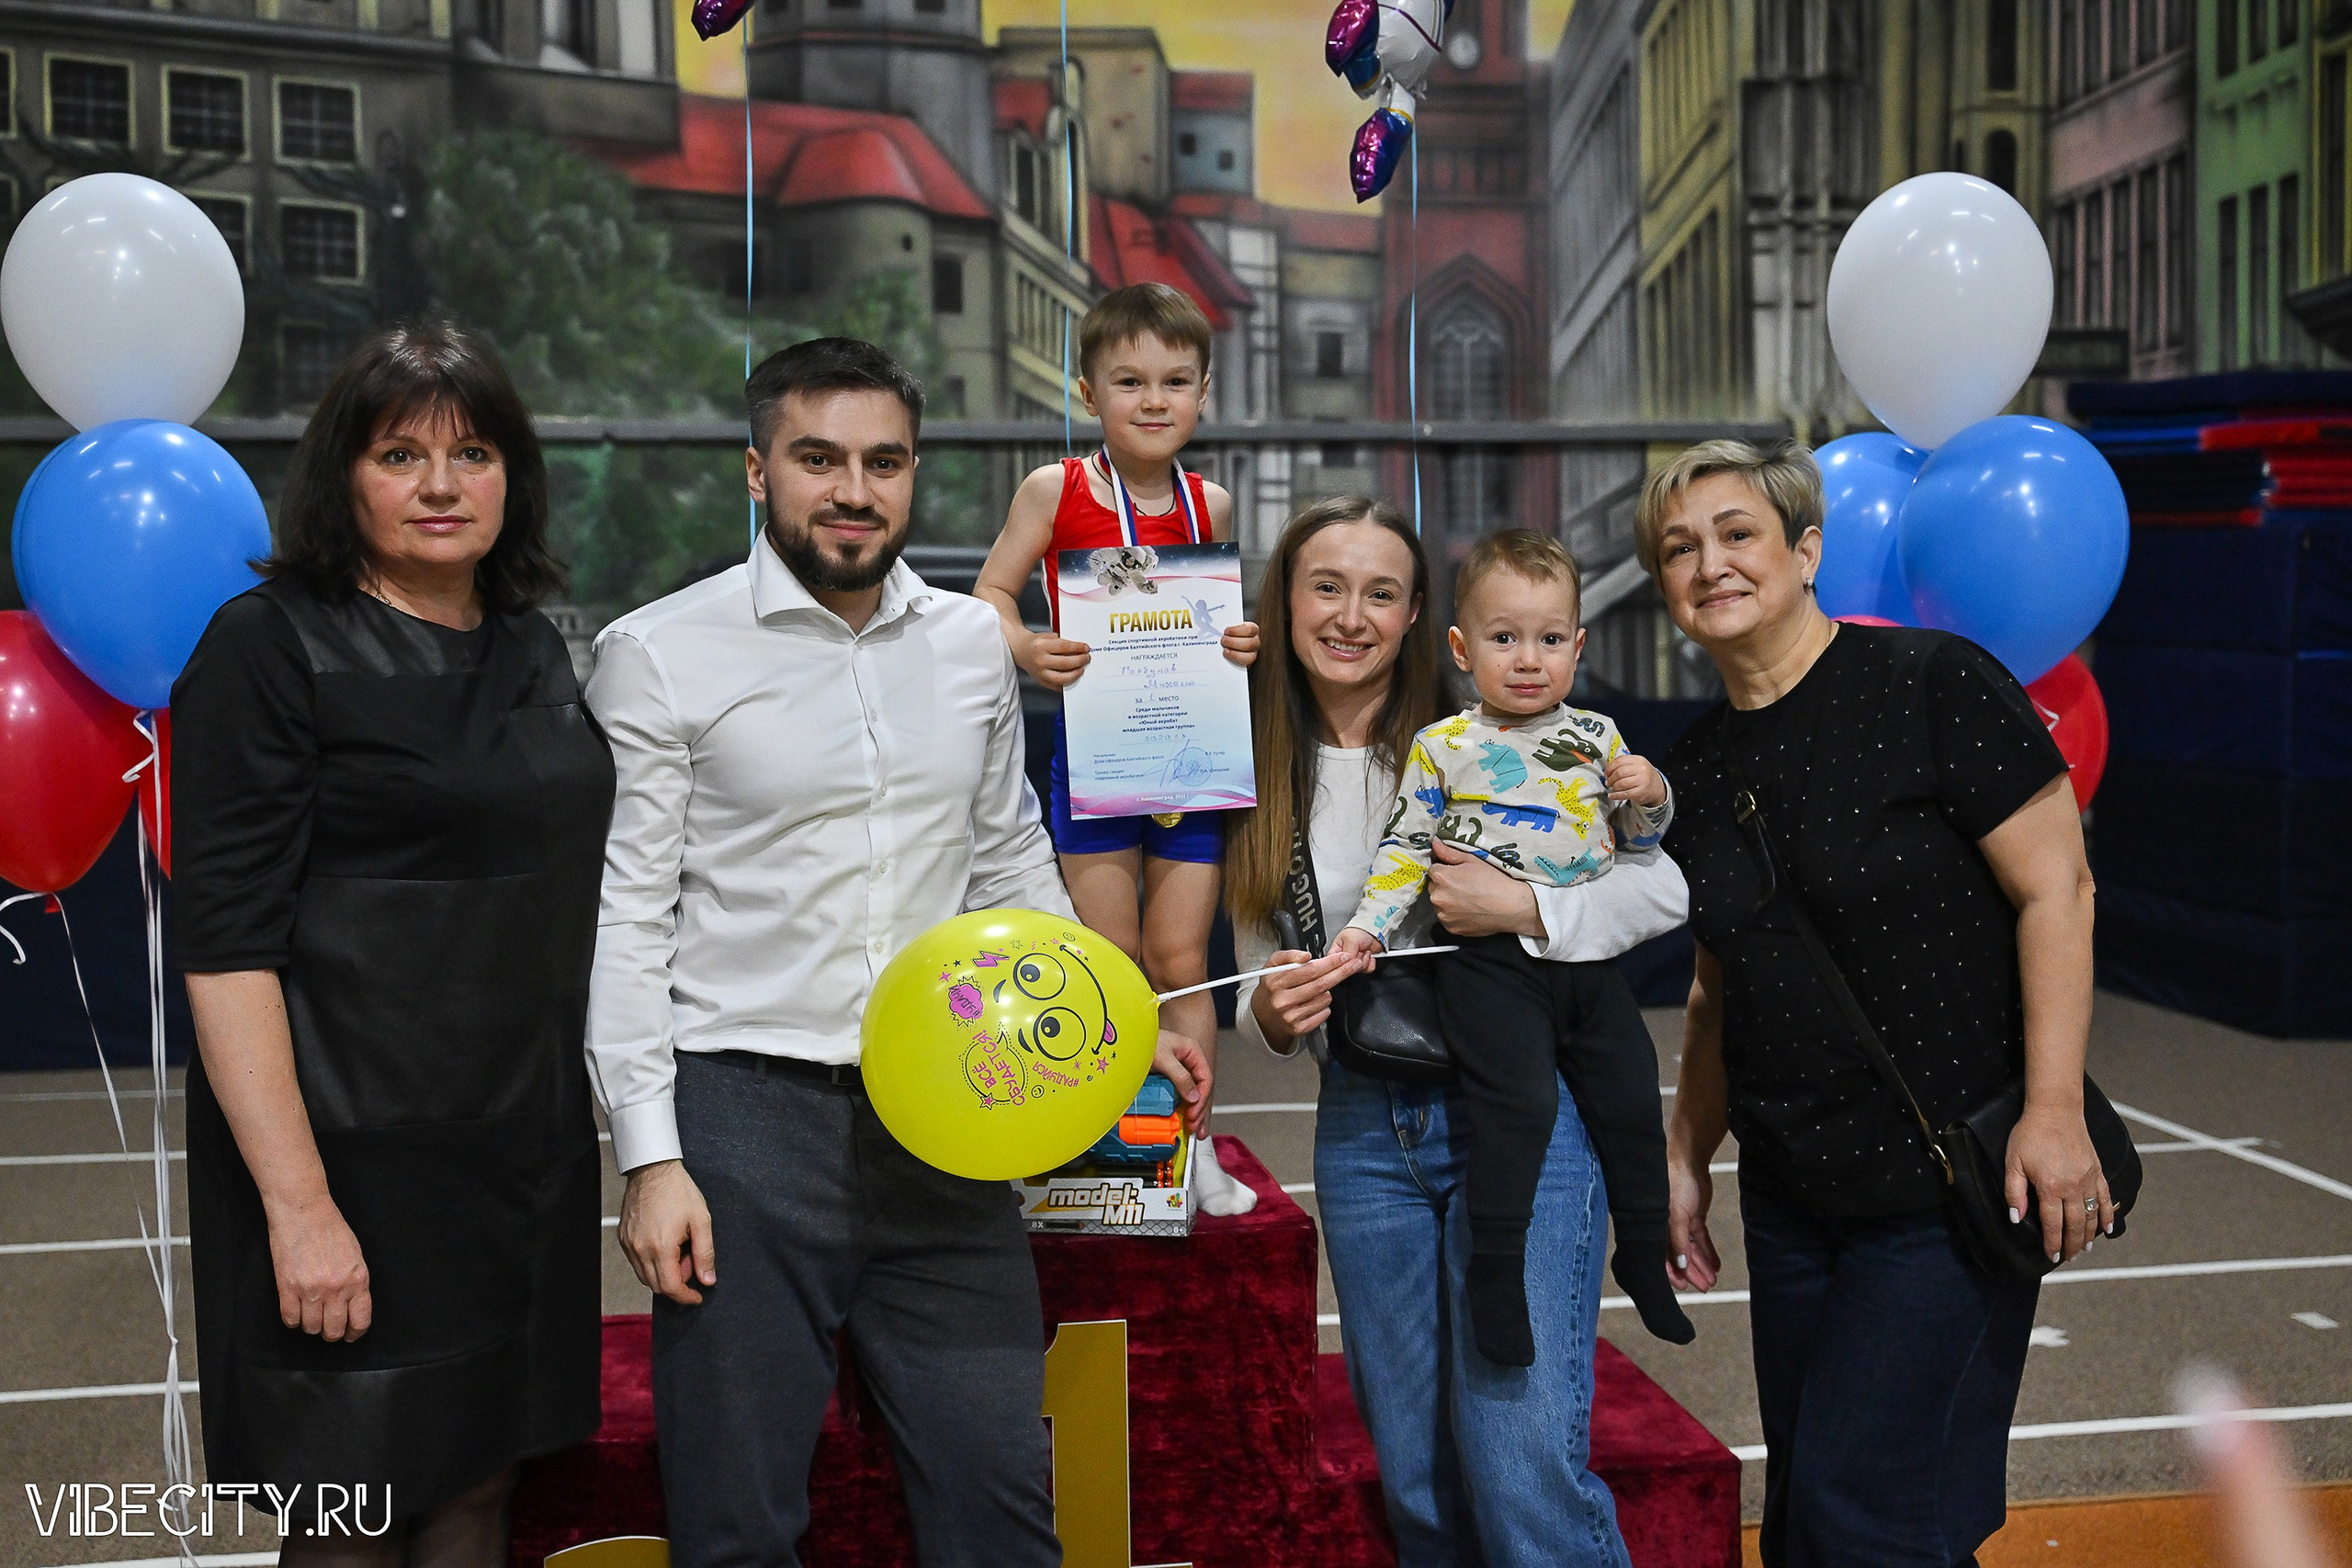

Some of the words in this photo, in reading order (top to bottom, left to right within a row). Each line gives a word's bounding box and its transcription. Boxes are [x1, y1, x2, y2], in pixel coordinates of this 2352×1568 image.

[1109, 609, 1193, 634] ГРАМОТА
[1128, 637, 1158, 645] спортивной
[1130, 652, 1178, 661] НАГРАЖДАЕТСЯ
[1289, 854, 1317, 933] HUGO
[947, 984, 982, 1018] #УДАЧИ
[971, 1061, 997, 1089] ВСЁ
[1032, 1060, 1080, 1089] #РАДУЙСЯ
